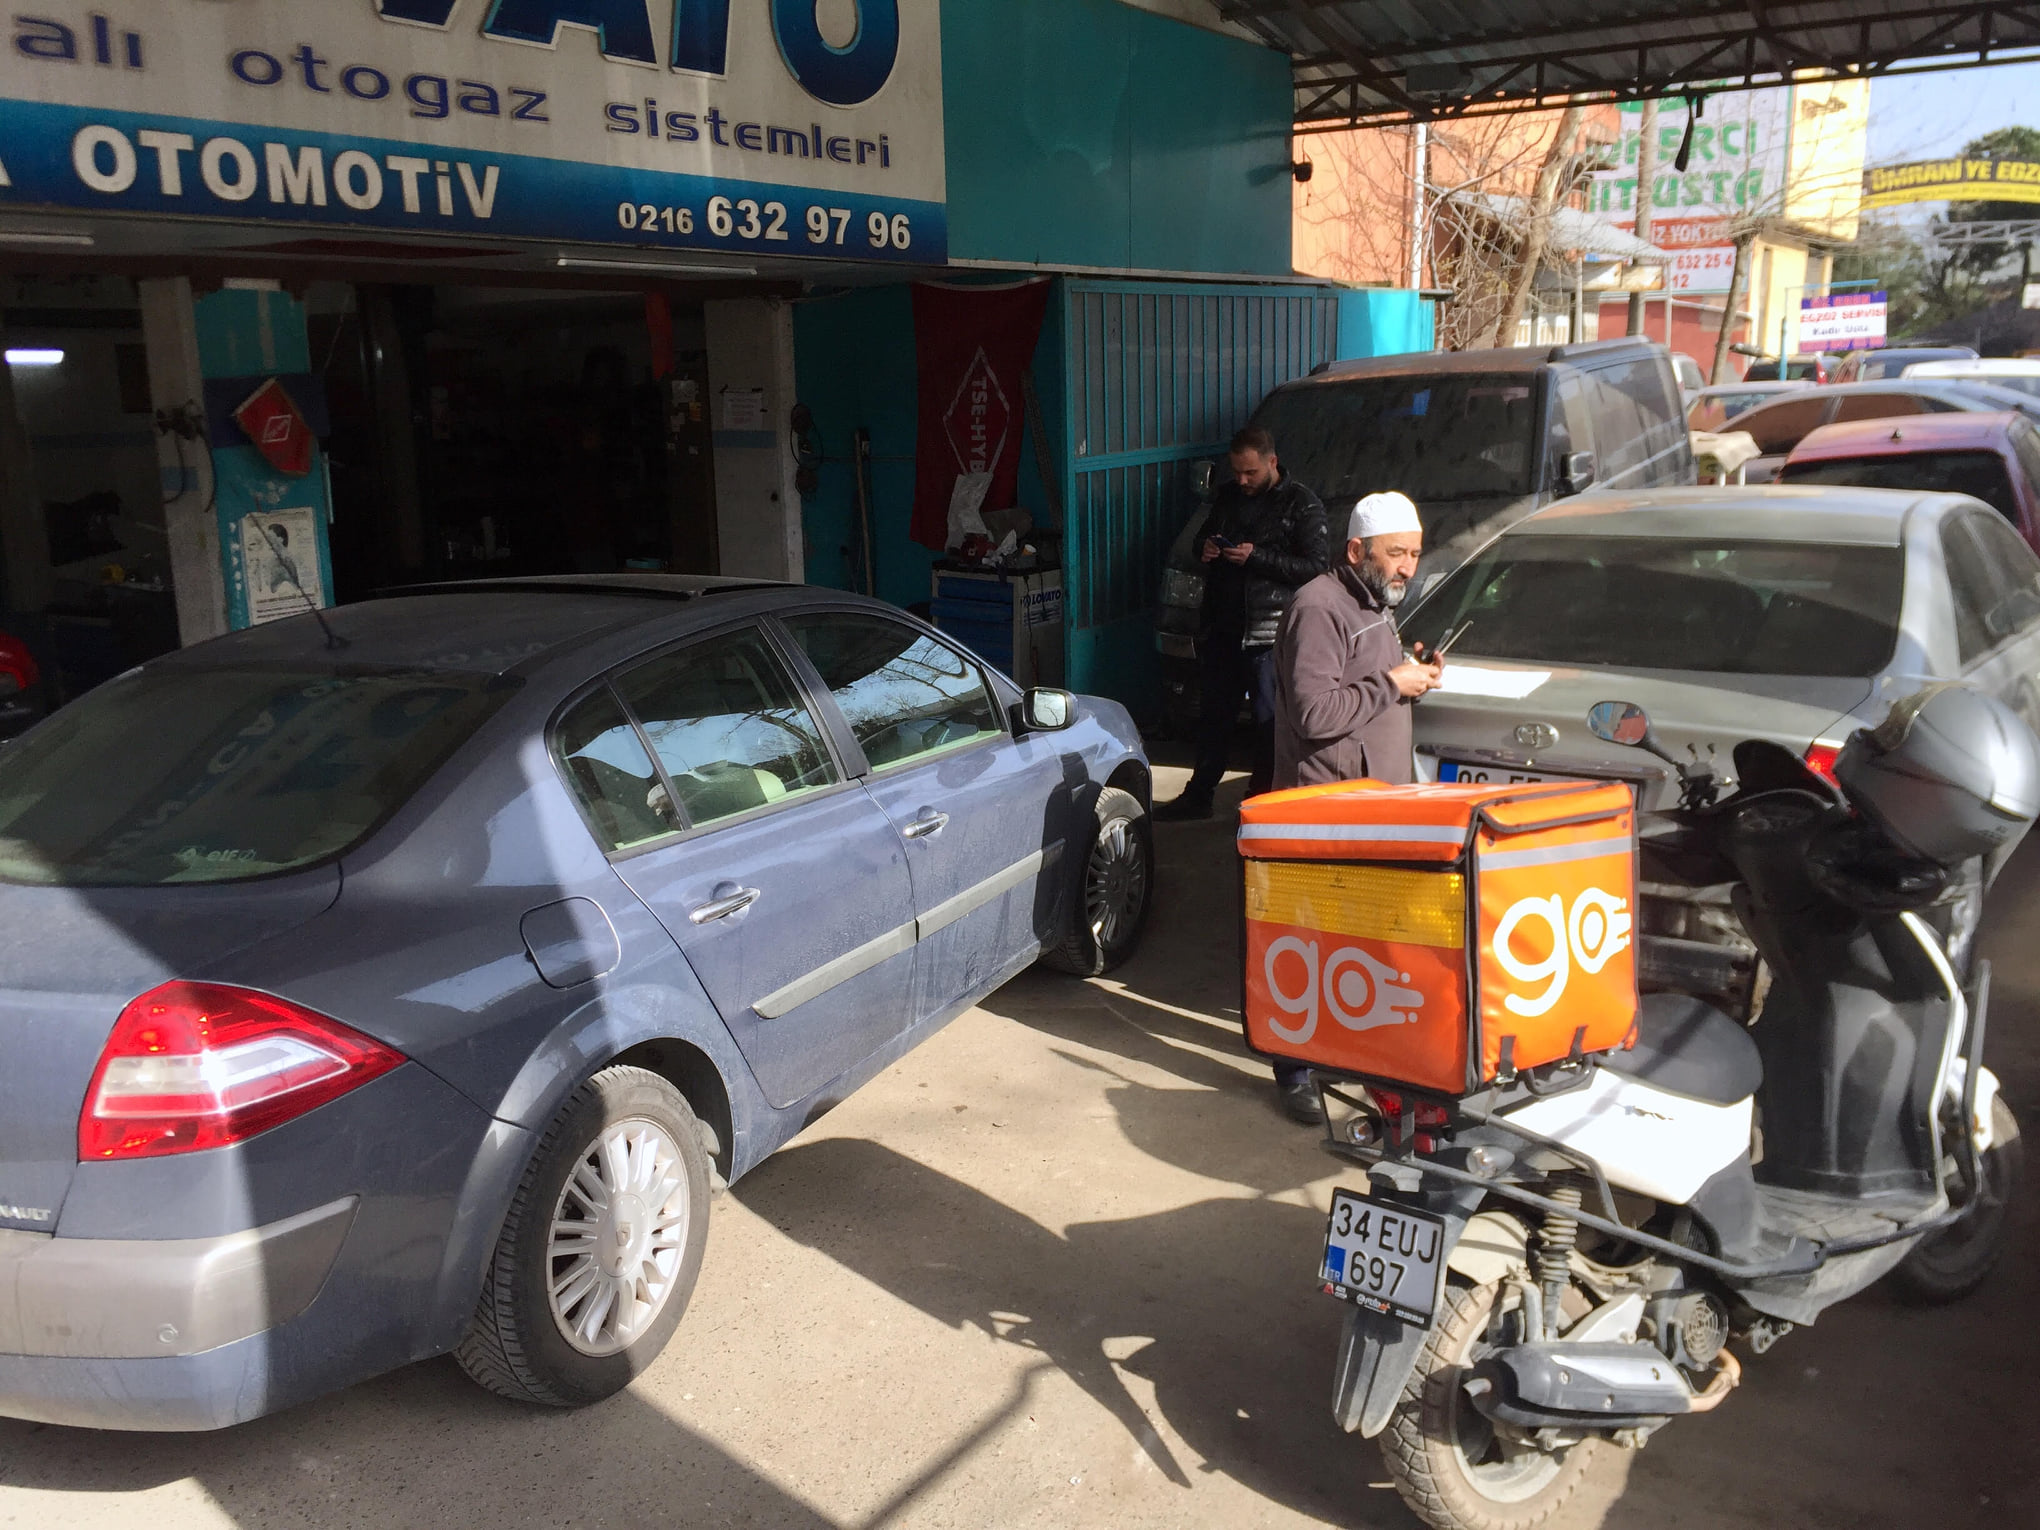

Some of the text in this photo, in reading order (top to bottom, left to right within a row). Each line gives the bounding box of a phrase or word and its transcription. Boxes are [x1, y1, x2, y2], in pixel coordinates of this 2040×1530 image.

[228, 45, 551, 122] otogaz
[605, 97, 891, 169] sistemleri
[617, 194, 912, 251] 0216 632 97 96
[1676, 255, 1701, 271] 632
[1704, 254, 1721, 270] 25
[969, 376, 989, 473] TSE-HYB
[1263, 935, 1425, 1045] go
[1493, 886, 1632, 1018] go
[1336, 1203, 1438, 1264] 34 EUJ
[1350, 1251, 1408, 1297] 697
